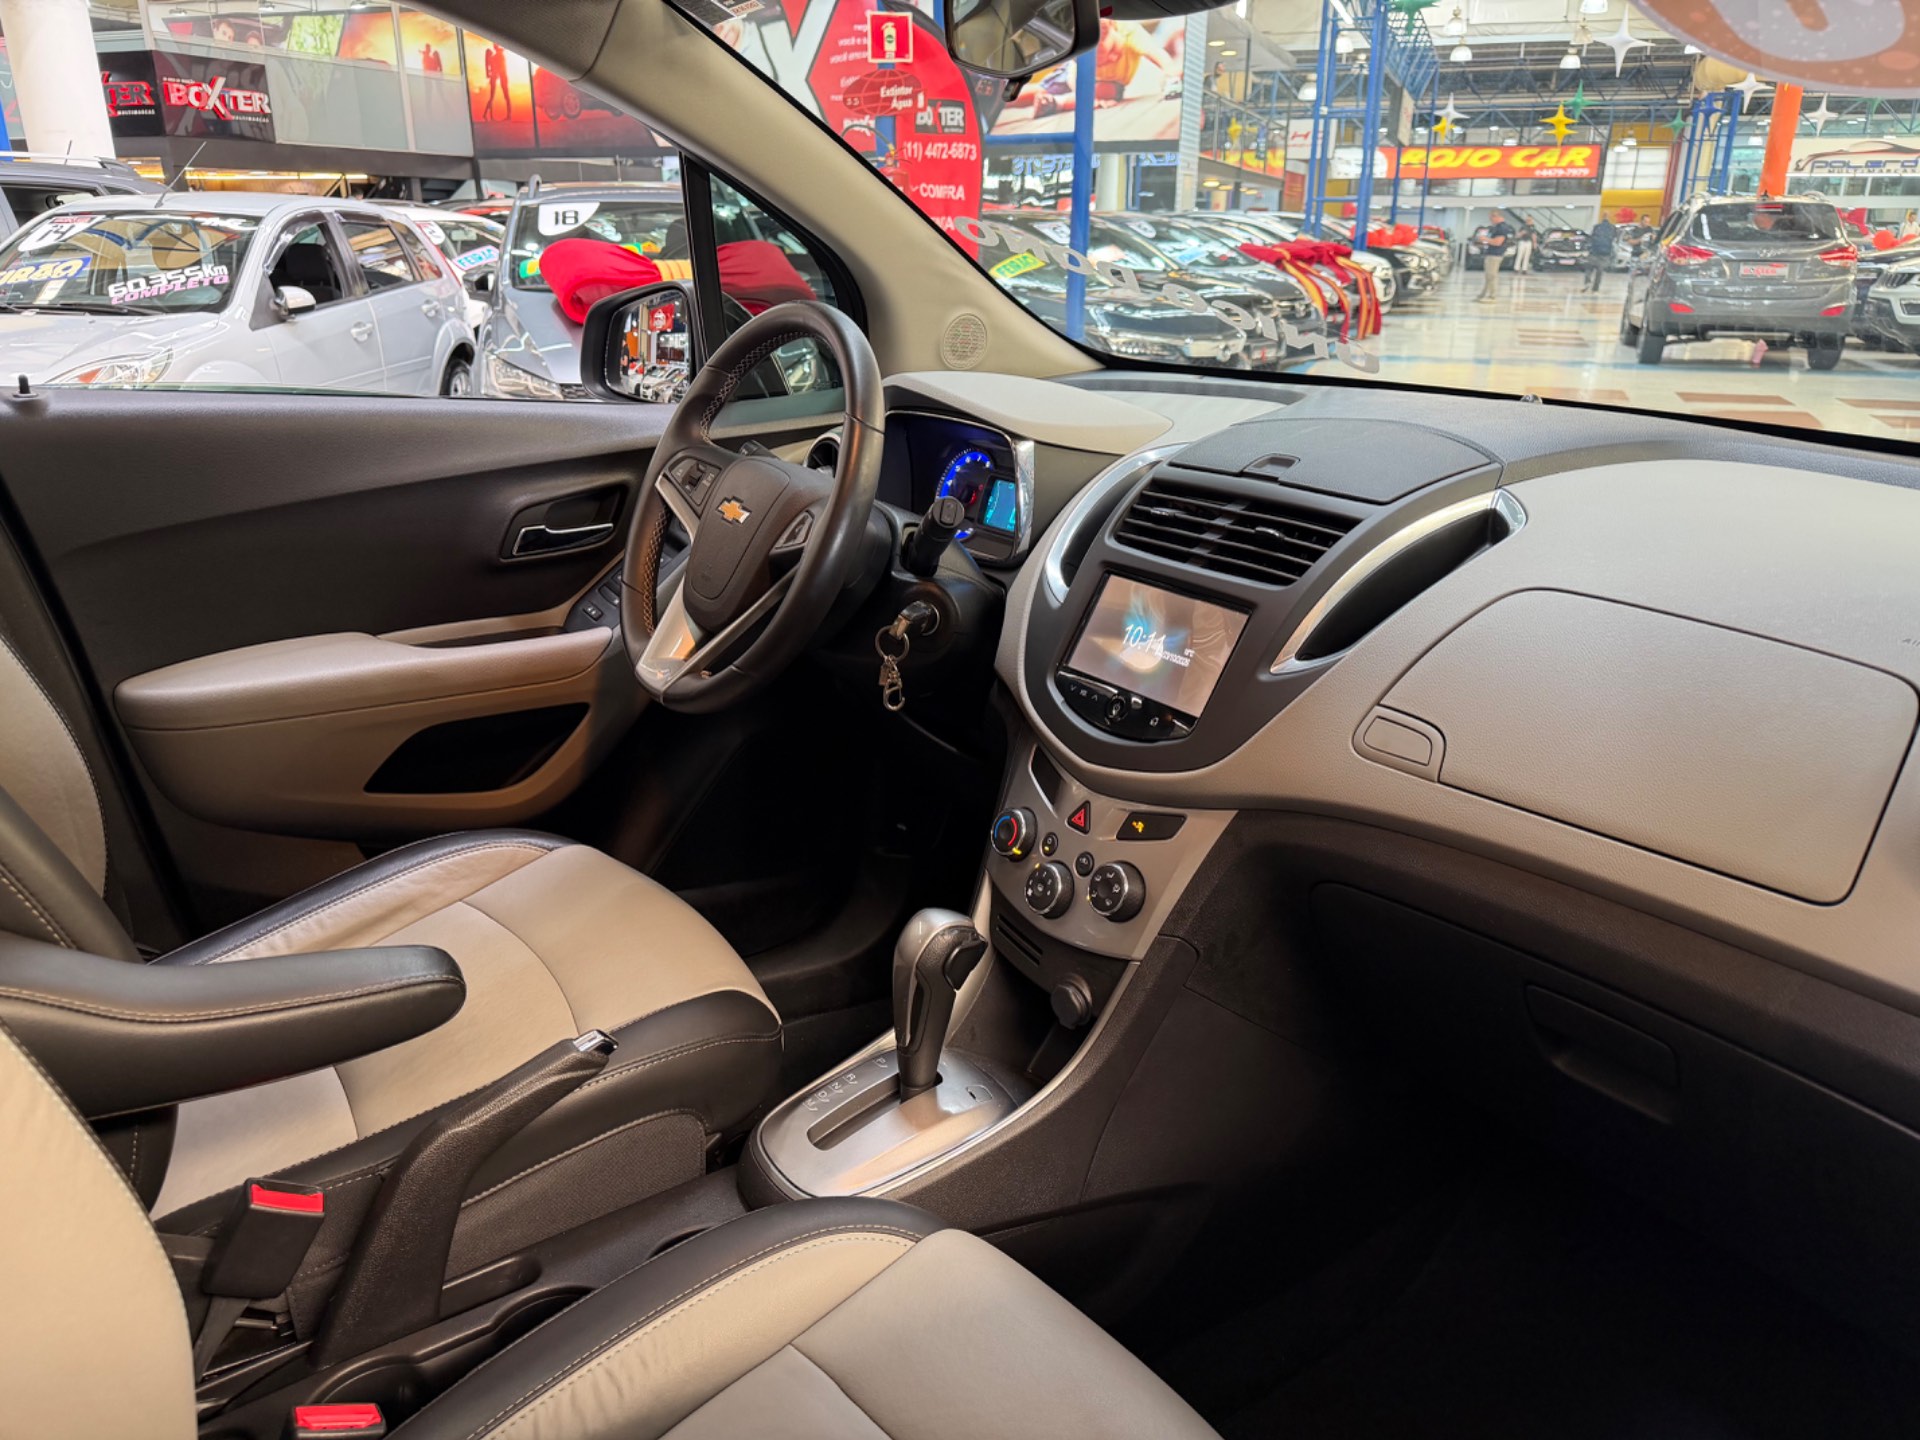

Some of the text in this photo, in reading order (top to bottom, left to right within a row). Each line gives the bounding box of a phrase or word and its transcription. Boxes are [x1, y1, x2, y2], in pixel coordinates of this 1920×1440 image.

[163, 76, 271, 121] BOXTER
[880, 85, 913, 98] Extintor
[891, 97, 913, 111] Água
[1400, 147, 1502, 168] ROJO
[1509, 146, 1593, 168] CAR
[919, 182, 966, 201] COMPRA
[553, 210, 580, 226] 18
[110, 274, 230, 305] COMPLETO
